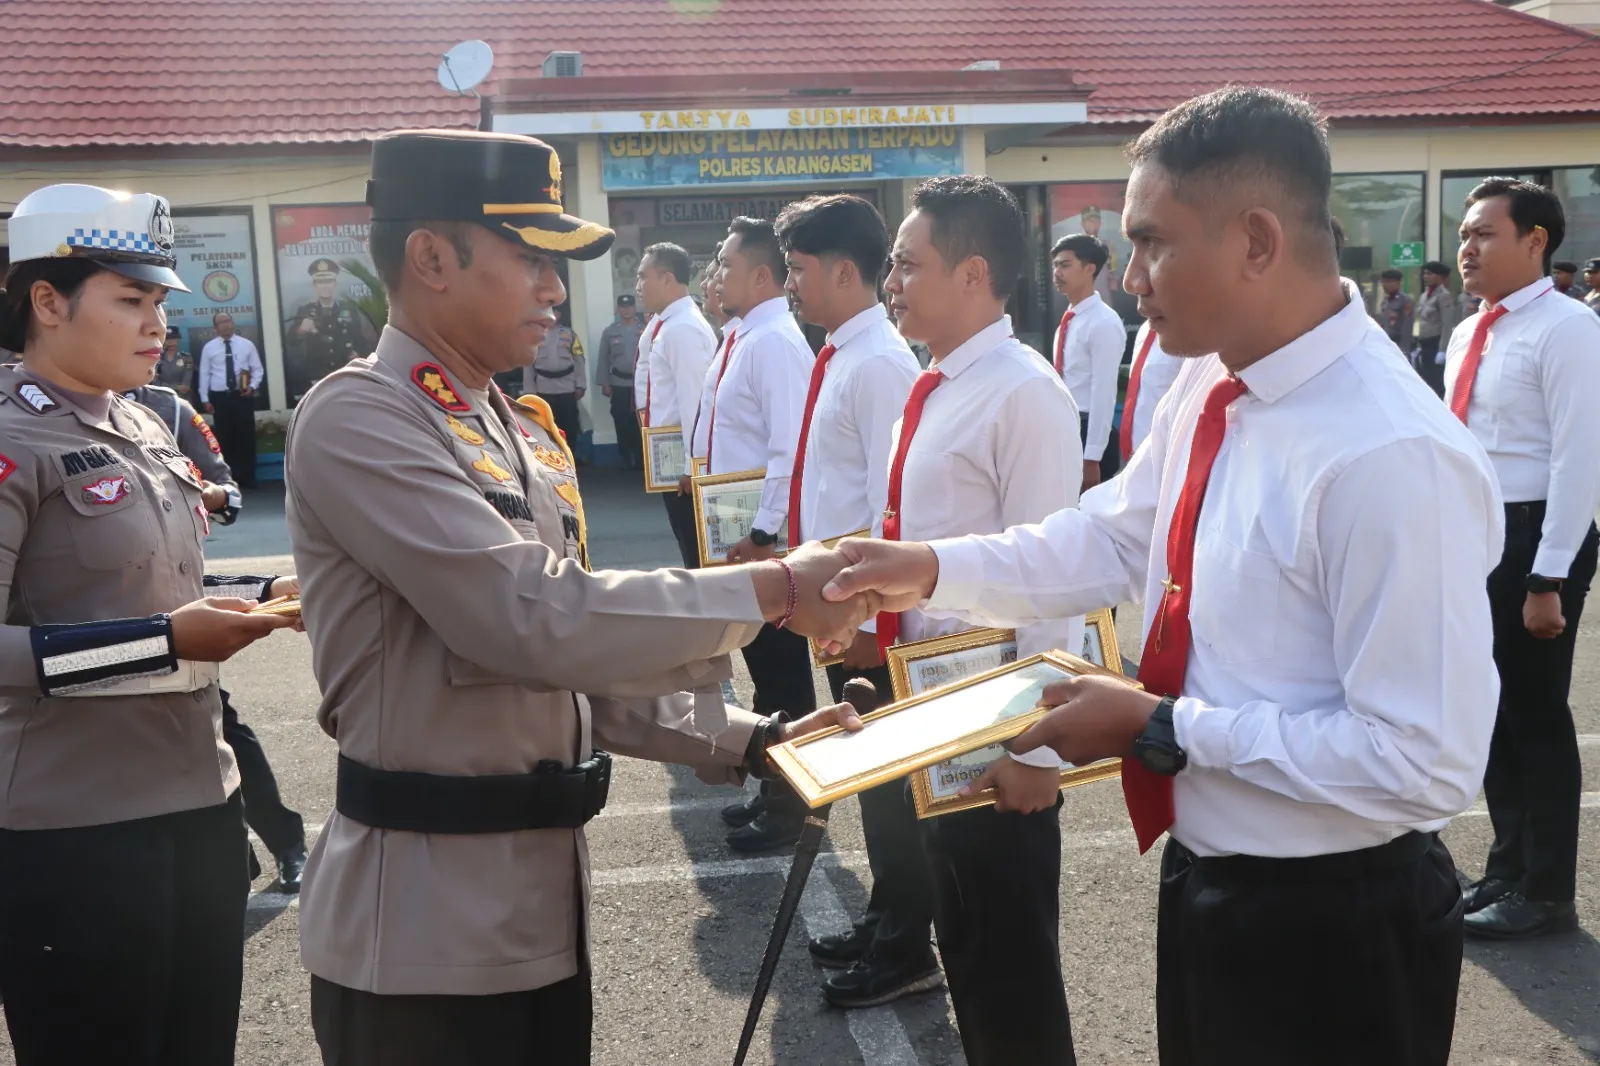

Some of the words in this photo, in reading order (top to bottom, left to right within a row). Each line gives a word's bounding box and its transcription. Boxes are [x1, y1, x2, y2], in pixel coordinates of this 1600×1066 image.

[640, 110, 751, 129] TANTYA
[788, 105, 956, 126] SUDHIRAJATI
[609, 131, 707, 158] GEDUNG
[711, 126, 850, 154] PELAYANAN
[856, 124, 956, 150] TERPADU
[700, 157, 761, 178] POLRES
[764, 153, 873, 176] KARANGASEM
[663, 201, 733, 223] SELAMAT
[310, 225, 335, 238] ANDA
[190, 251, 247, 262] PELAYANAN
[206, 260, 234, 270] SKCK
[193, 307, 209, 317] SAT
